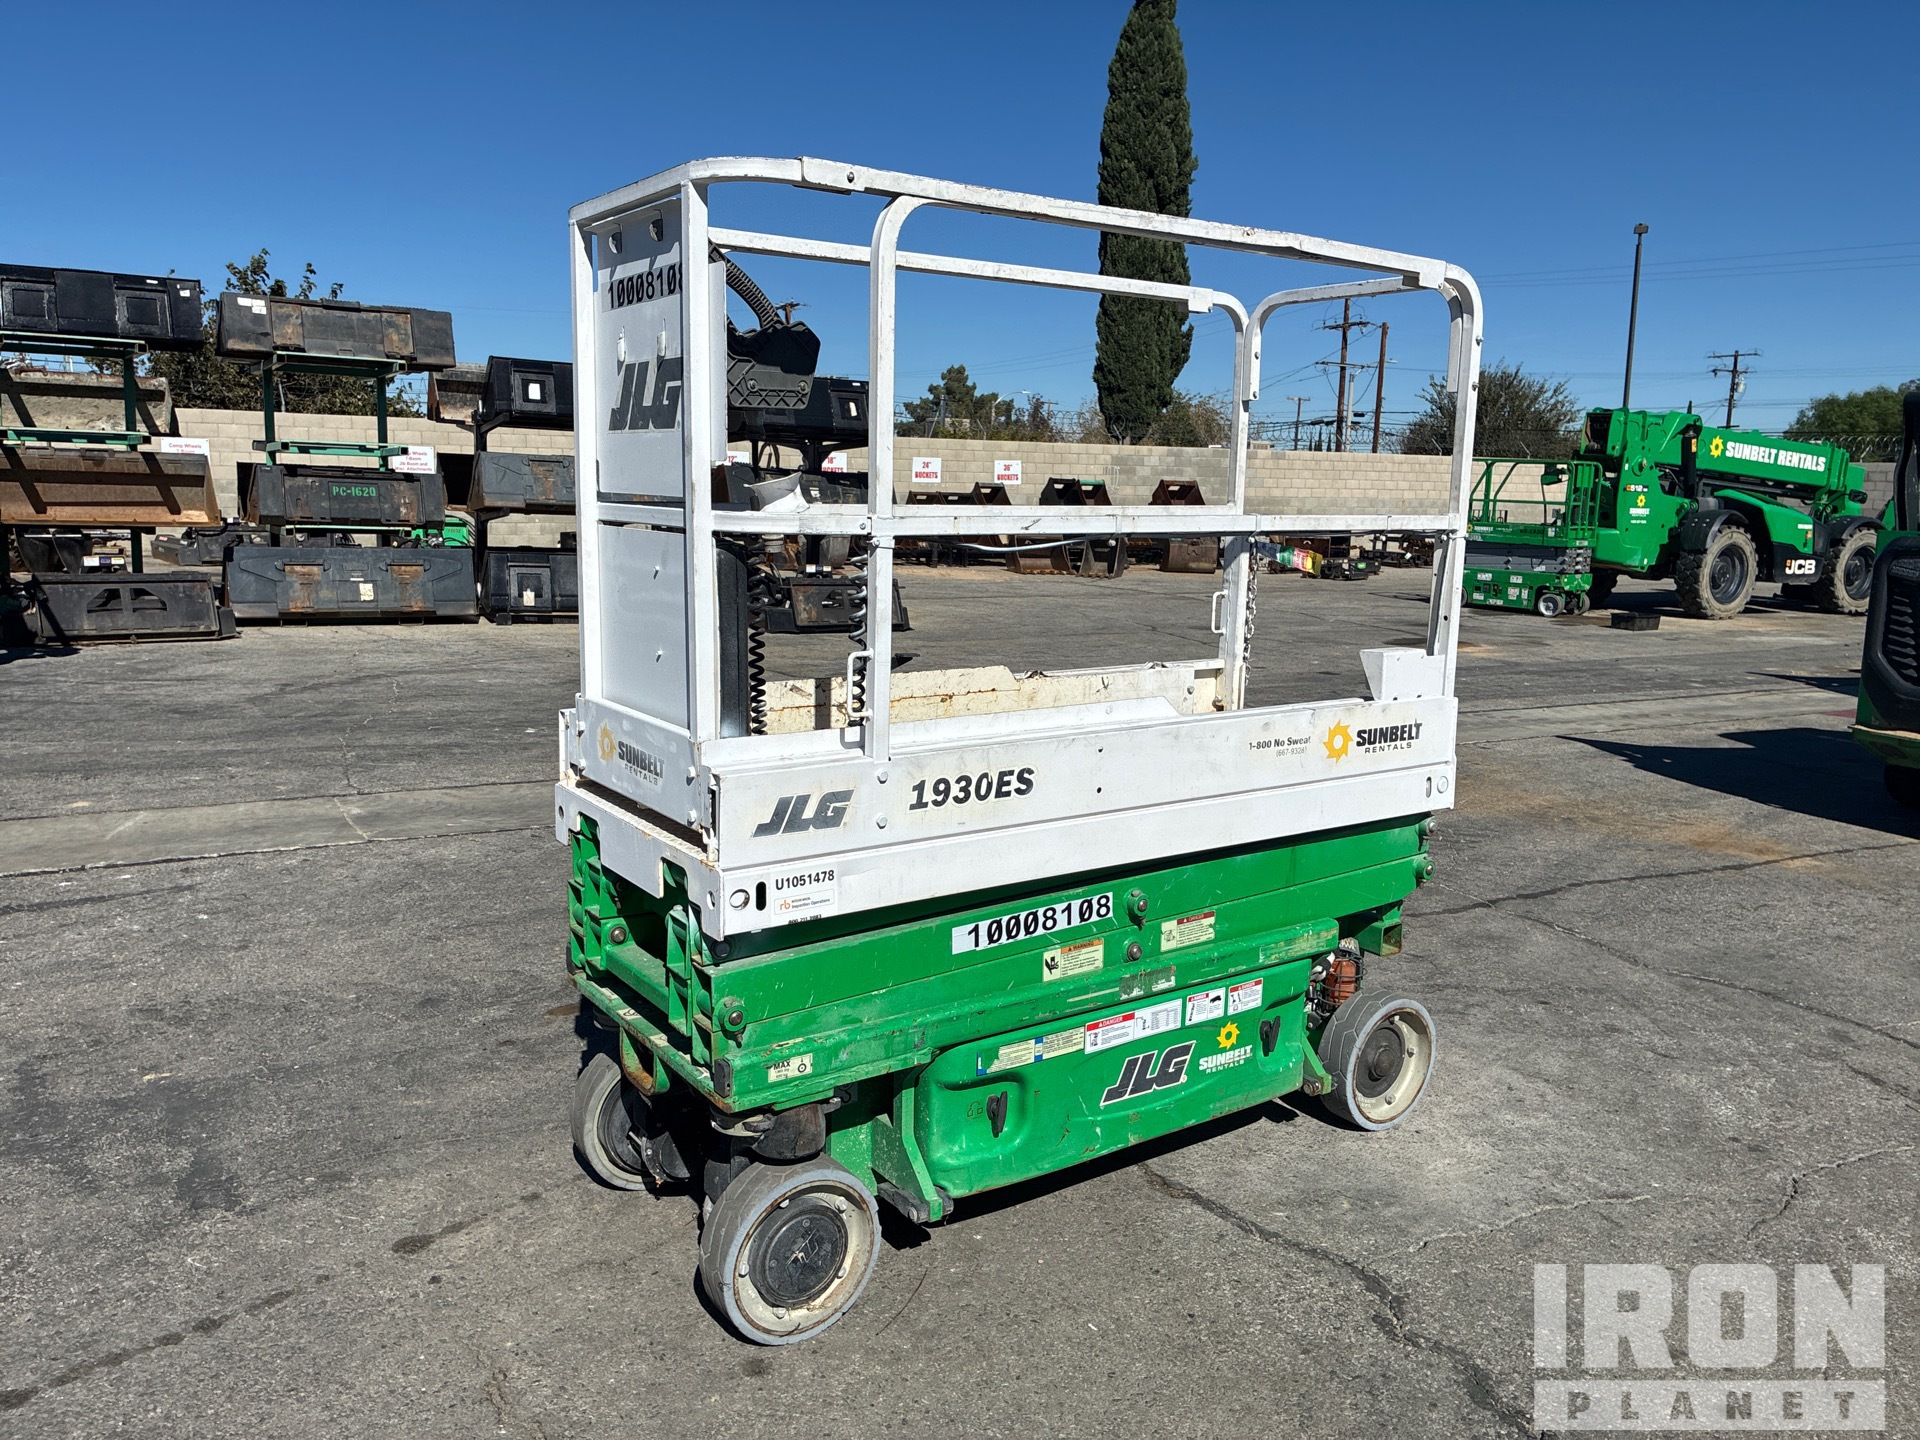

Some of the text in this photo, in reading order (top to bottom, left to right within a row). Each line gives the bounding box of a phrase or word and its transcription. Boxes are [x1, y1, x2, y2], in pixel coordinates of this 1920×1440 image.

[609, 356, 683, 431] JLG
[922, 461, 931, 469] 24"
[1725, 441, 1826, 472] SUNBELT RENTALS
[915, 471, 938, 479] BUCKETS
[997, 473, 1019, 481] BUCKETS
[1785, 559, 1816, 574] JCB
[1249, 736, 1311, 751] 1-800 No Sweat
[1356, 723, 1422, 748] SUNBELT
[1364, 742, 1412, 754] RENTALS
[618, 740, 665, 779] SUNBELT
[624, 763, 658, 785] RENTALS
[908, 767, 1035, 811] 1930ES
[752, 789, 854, 838] JLG
[775, 869, 835, 890] U1051478
[967, 894, 1111, 948] 10008108
[1073, 940, 1095, 950] WARNING
[1102, 1016, 1123, 1026] DANGER
[773, 1060, 791, 1070] MAX
[1199, 1045, 1253, 1071] SUNBELT
[1206, 1060, 1245, 1074] RENTALS
[1101, 1041, 1196, 1107] JLG
